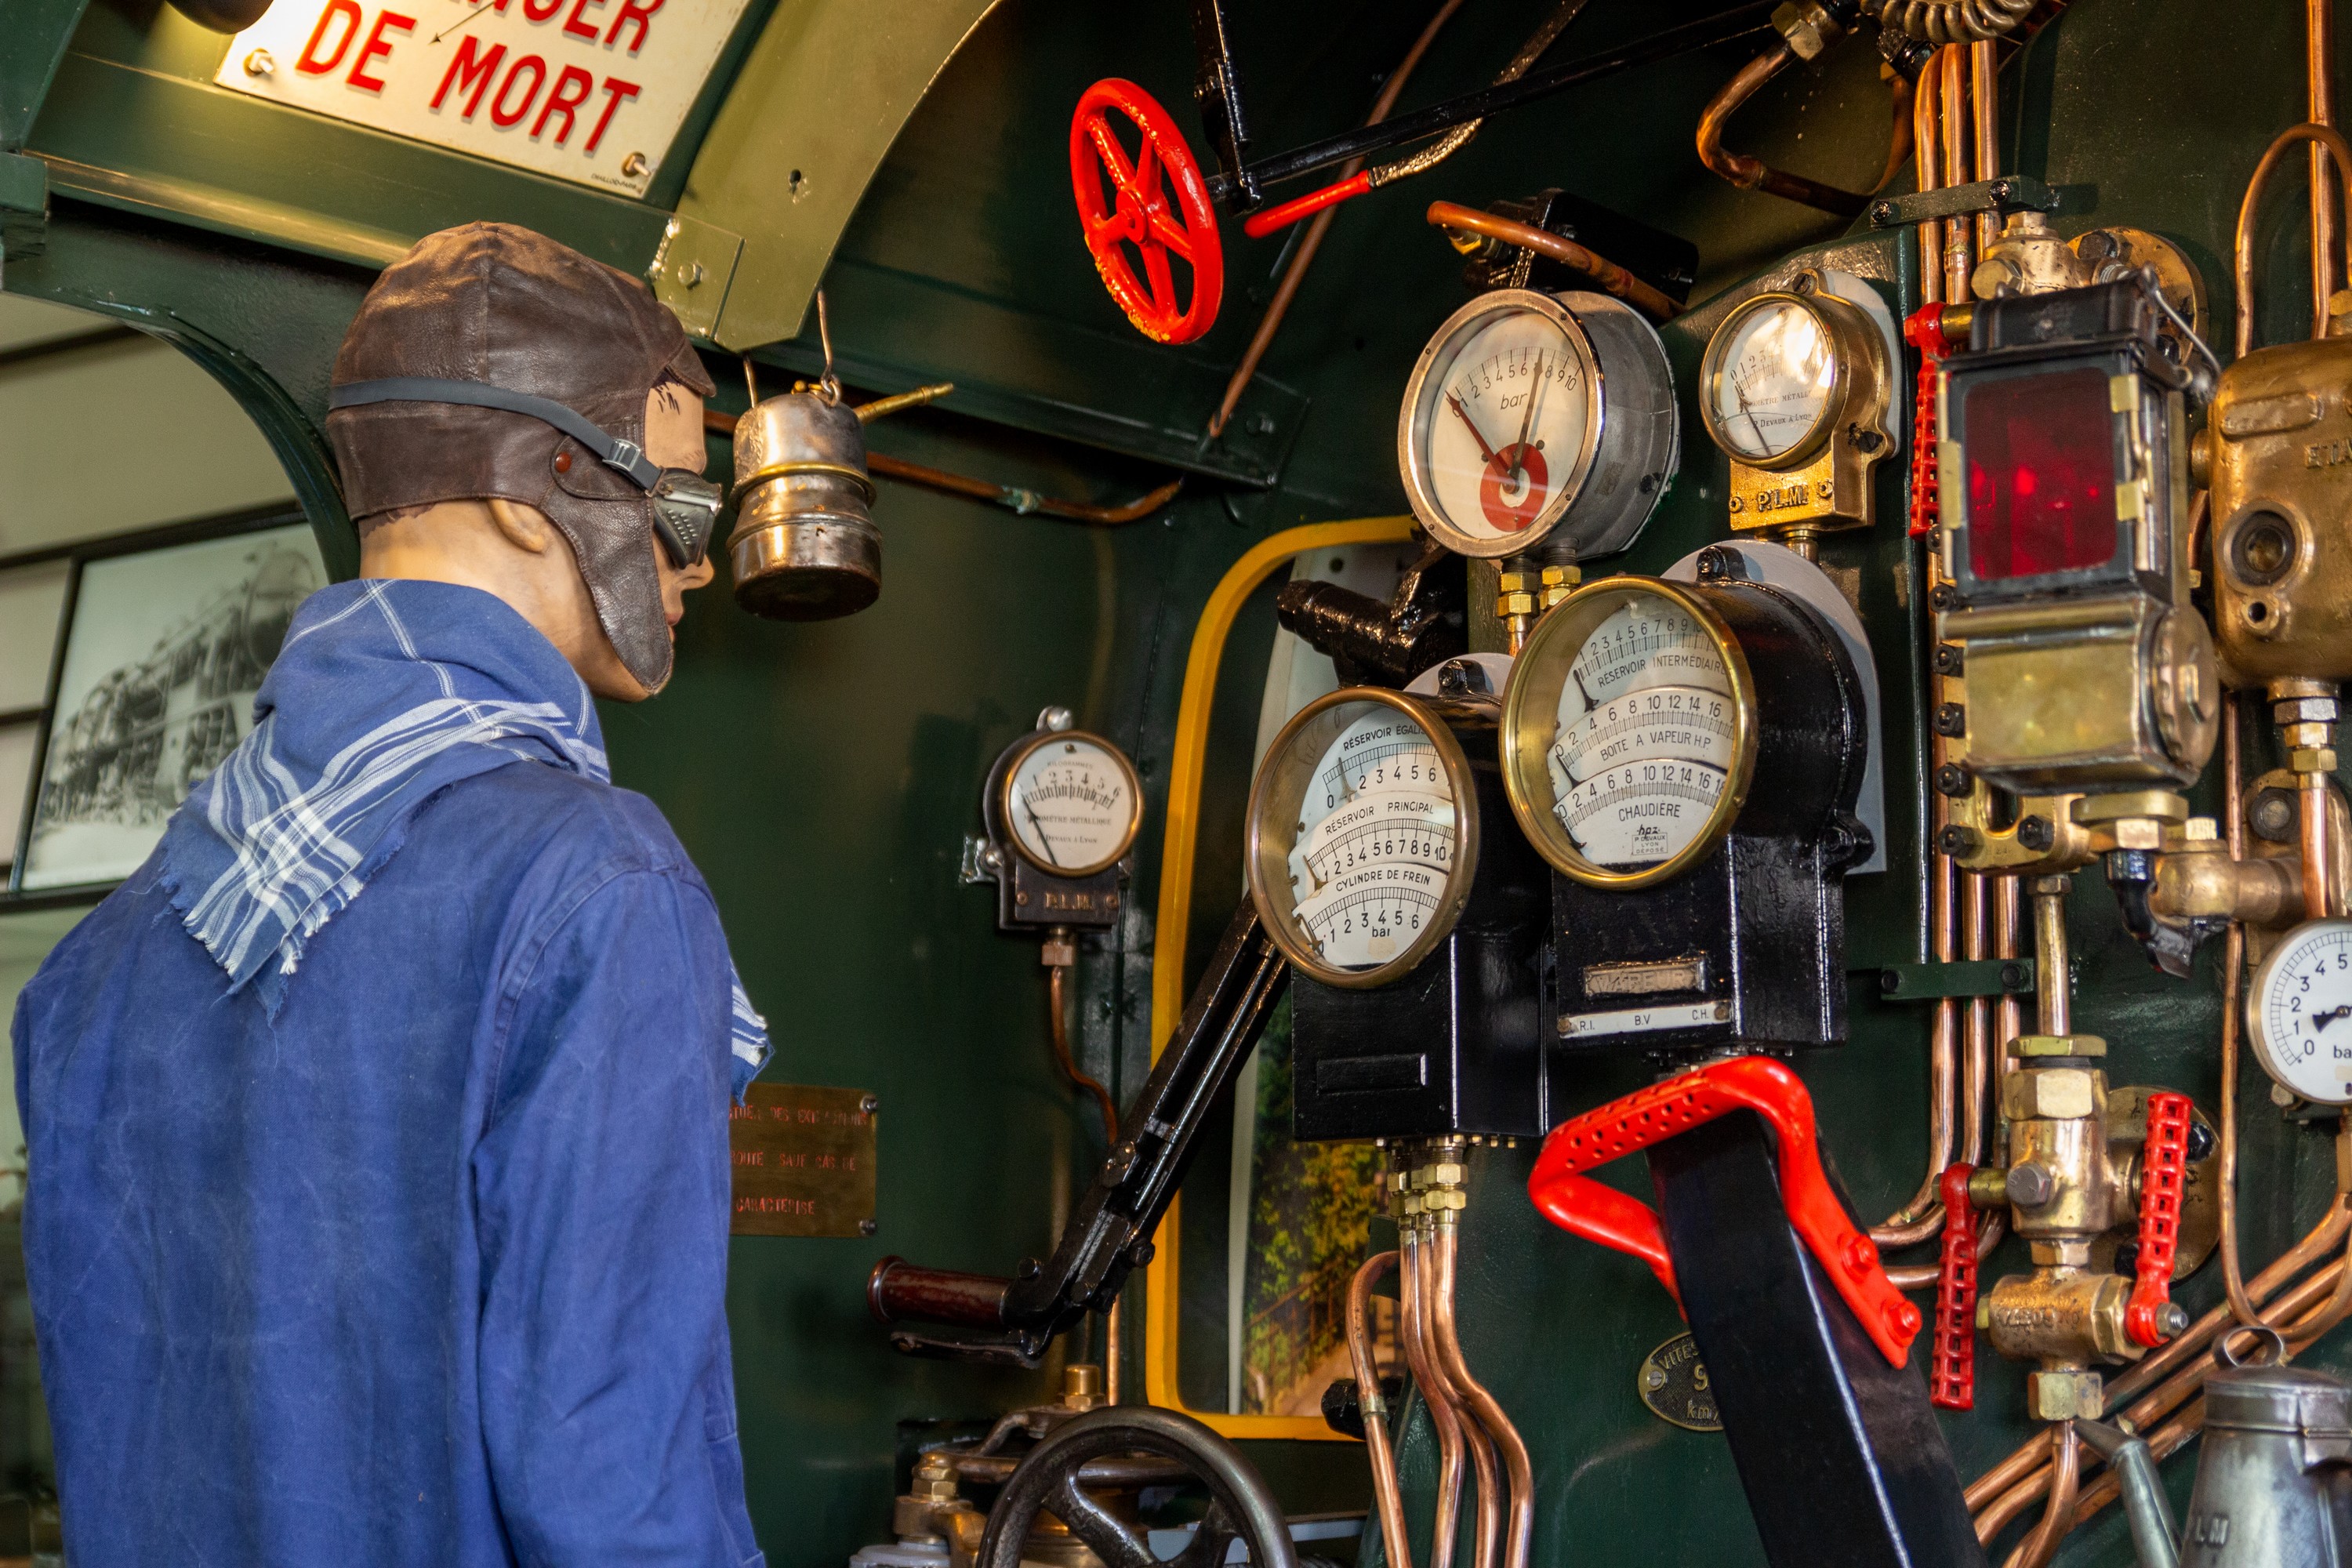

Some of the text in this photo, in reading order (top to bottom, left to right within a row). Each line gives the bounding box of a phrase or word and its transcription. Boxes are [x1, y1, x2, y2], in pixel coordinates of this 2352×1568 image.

[295, 0, 417, 92] DE
[429, 34, 642, 153] MORT
[1730, 369, 1737, 381] 0
[1740, 362, 1747, 375] 1
[1749, 355, 1757, 369] 2
[1461, 397, 1468, 408] 1
[1471, 385, 1480, 399] 2
[1483, 376, 1491, 389] 3
[1496, 370, 1504, 382] 4
[1508, 365, 1515, 378] 5
[1520, 362, 1528, 376] 6
[1544, 365, 1553, 379] 8
[1556, 369, 1565, 383] 9
[1564, 375, 1577, 391] 10
[1500, 393, 1528, 410] bar
[1760, 418, 1786, 428] DEVAUX
[1580, 651, 1585, 662] 1
[1591, 642, 1599, 656] 2
[1602, 637, 1610, 649] 3
[1615, 630, 1622, 642] 4
[1628, 626, 1635, 639] 5
[1641, 622, 1647, 635] 6
[1654, 619, 1661, 633] 7
[1667, 618, 1675, 632] 8
[1681, 618, 1688, 631] 9
[1597, 659, 1646, 688] RÉSERVOIR
[1343, 727, 1392, 752] RÉSERVOIR
[1555, 695, 1722, 757] 0 2 4 6 8 10 12 14 16
[1600, 731, 1711, 762] BOITE A VAPEUR H.P.
[1049, 771, 1057, 783] 2
[1065, 770, 1073, 782] 3
[1081, 772, 1088, 784] 4
[1098, 776, 1105, 789] 5
[1113, 786, 1121, 797] 6
[1327, 765, 1436, 808] 0 2 3 4 5 6
[1558, 804, 1567, 819] 0
[1573, 793, 1582, 808] 2
[1589, 783, 1597, 797] 4
[1606, 775, 1616, 789] 6
[1625, 769, 1633, 784] 8
[1643, 765, 1656, 781] 10
[1662, 765, 1675, 781] 12
[1680, 768, 1692, 782] 14
[1699, 771, 1711, 789] 16
[1325, 801, 1434, 836] RÉSERVOIR PRINCIPAL
[1618, 800, 1681, 822] CHAUDIÈRE
[1324, 839, 1446, 881] 1 2 3 4 5 6 7 8 9 10
[1336, 869, 1431, 891] CYLINDRE DE FREIN
[1330, 910, 1419, 943] 1 2 3 4 5 6
[2291, 954, 2348, 1055] 0 1 2 3 4 5
[1580, 1009, 1709, 1031] R.I. B.V C.H.
[2333, 1045, 2352, 1058] ba
[779, 1153, 806, 1167] SAUF
[1658, 1341, 1700, 1370] VITES
[1693, 1364, 1708, 1391] 9
[1687, 1399, 1719, 1421] km/
